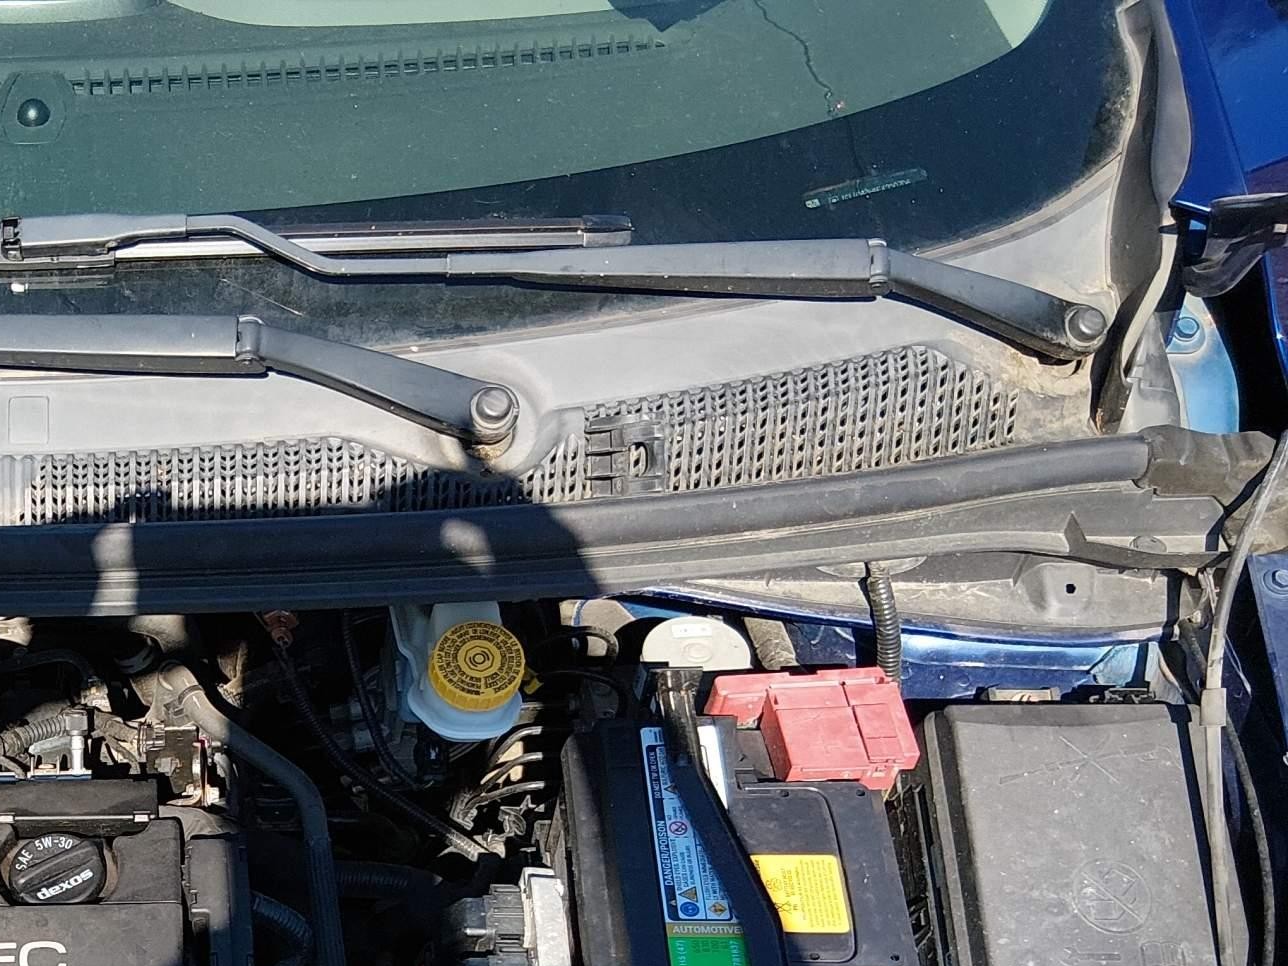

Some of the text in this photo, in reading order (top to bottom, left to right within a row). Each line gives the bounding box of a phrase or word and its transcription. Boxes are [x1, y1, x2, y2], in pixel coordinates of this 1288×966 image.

[14, 834, 74, 872] SAE 5W-30
[657, 820, 673, 886] DANGER/POISON
[35, 868, 94, 901] dexos
[672, 925, 741, 934] AUTOMOTIVE
